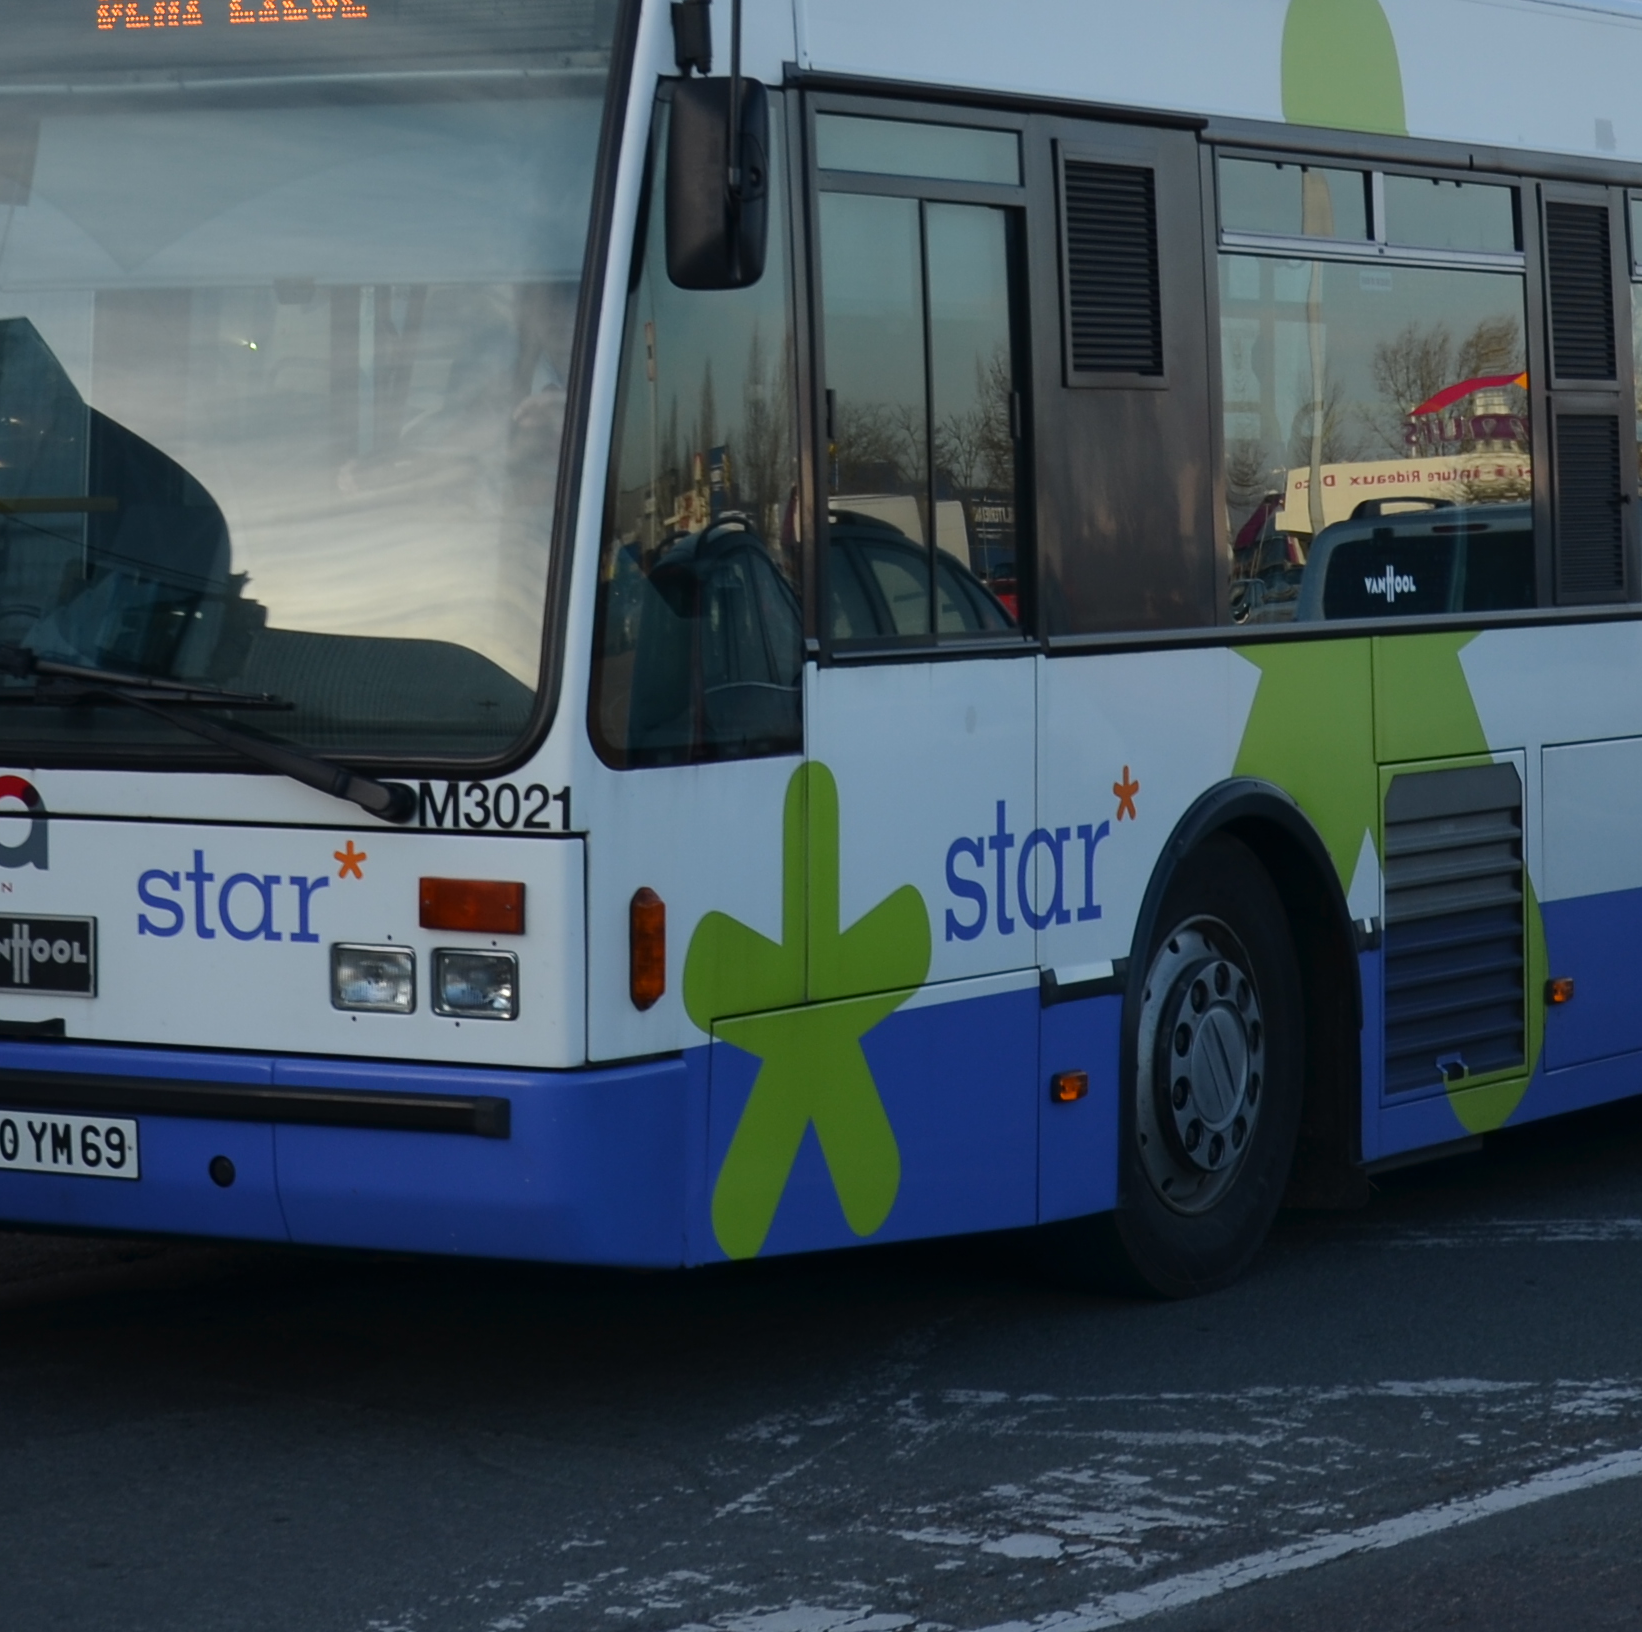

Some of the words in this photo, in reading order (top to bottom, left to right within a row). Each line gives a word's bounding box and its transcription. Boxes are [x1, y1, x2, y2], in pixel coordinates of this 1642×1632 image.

[417, 781, 573, 832] M3021
[27, 1120, 73, 1166] YM
[80, 1124, 126, 1169] 69
